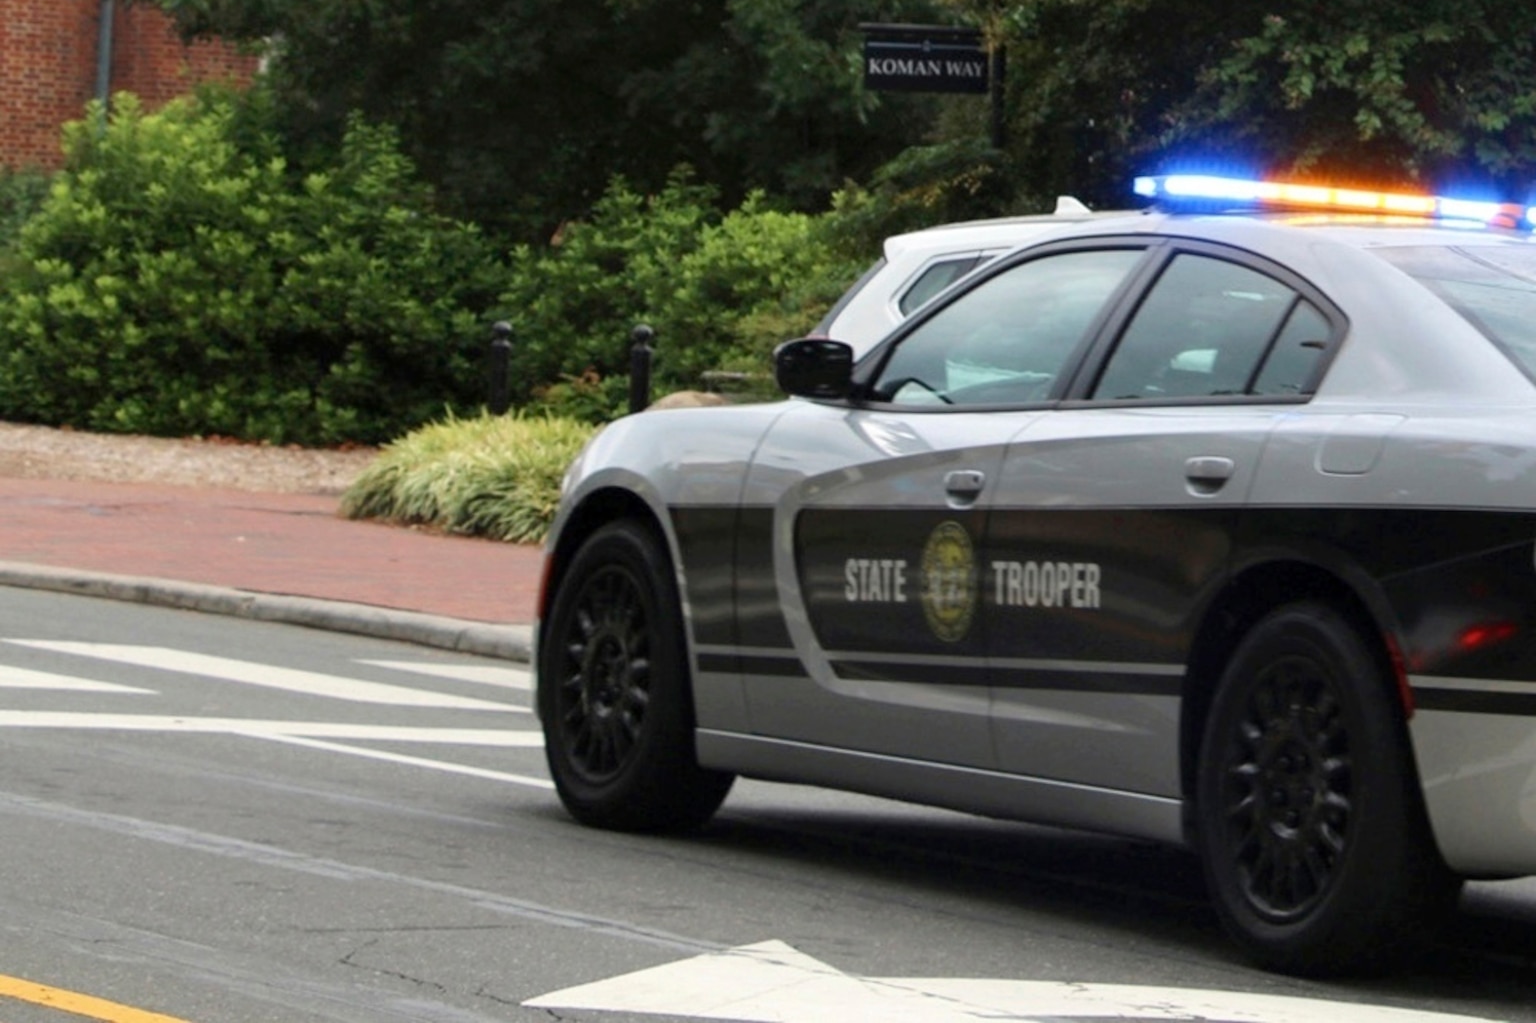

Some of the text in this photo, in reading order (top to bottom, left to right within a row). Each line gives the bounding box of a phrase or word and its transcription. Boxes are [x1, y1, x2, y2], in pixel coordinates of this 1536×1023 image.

[868, 57, 984, 77] KOMAN WAY
[844, 558, 1101, 608] STATE TROOPER
